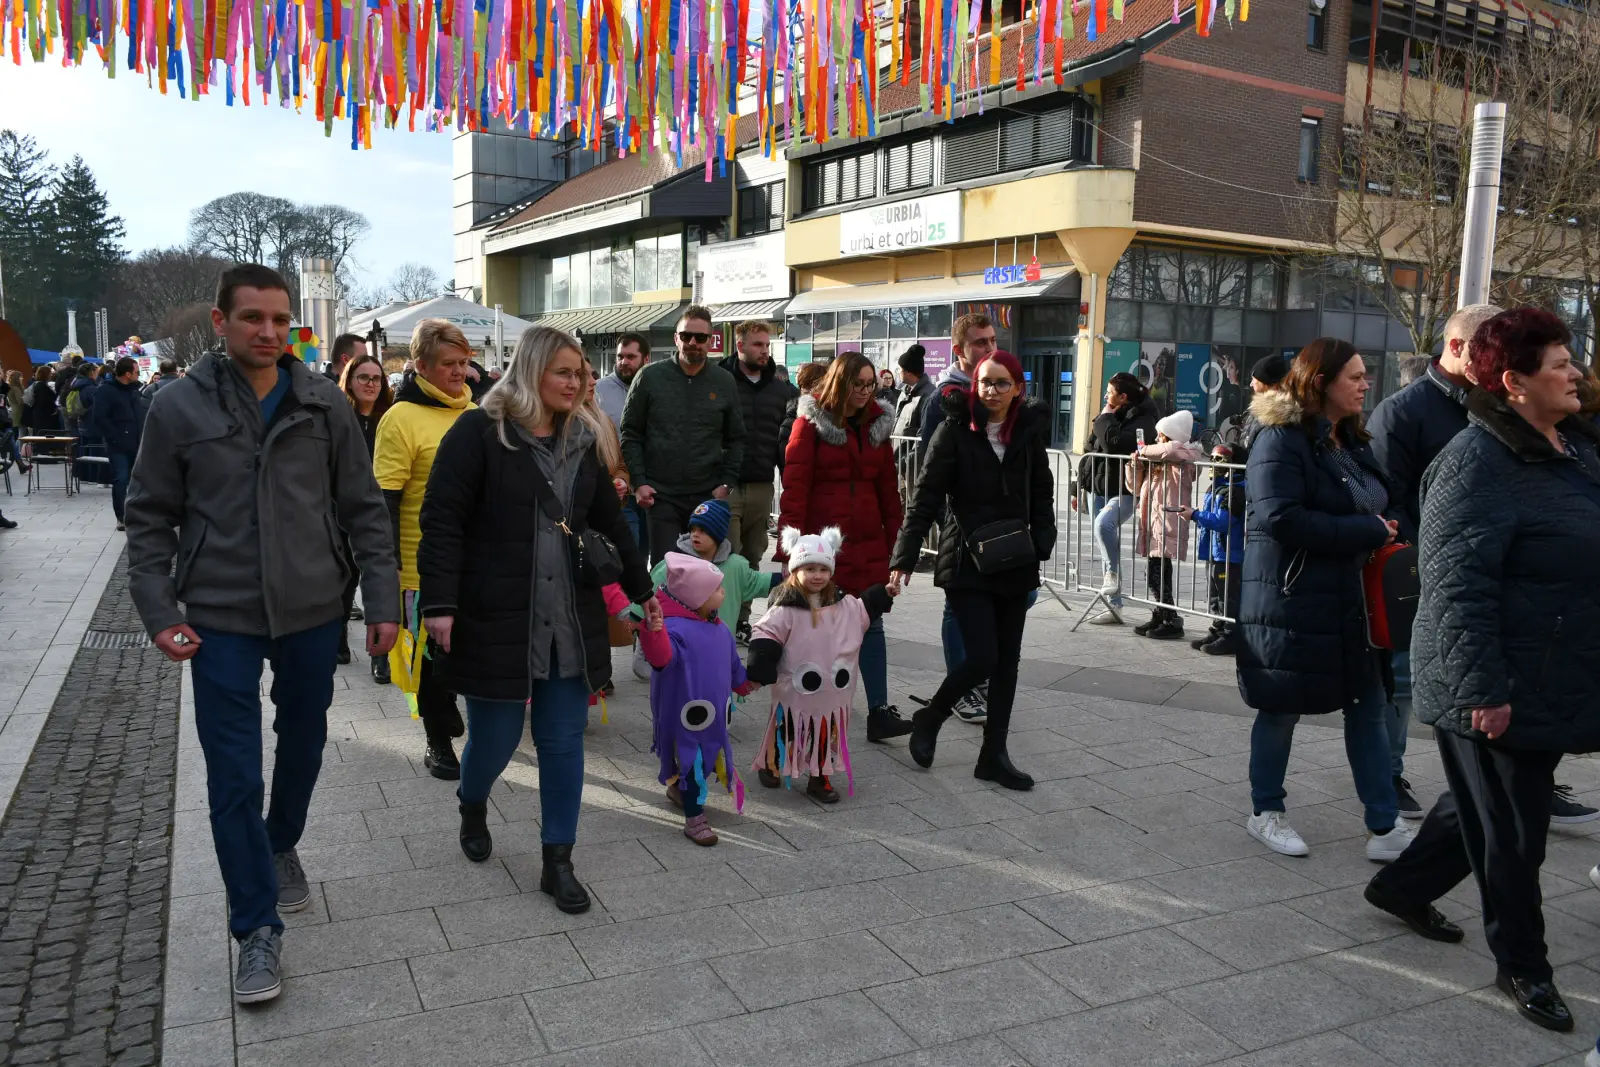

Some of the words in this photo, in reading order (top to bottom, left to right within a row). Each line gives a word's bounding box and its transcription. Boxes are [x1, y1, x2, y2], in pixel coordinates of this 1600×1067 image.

[886, 203, 922, 224] URBIA
[878, 231, 891, 248] et
[927, 222, 946, 241] 25
[984, 264, 1025, 285] ERSTE
